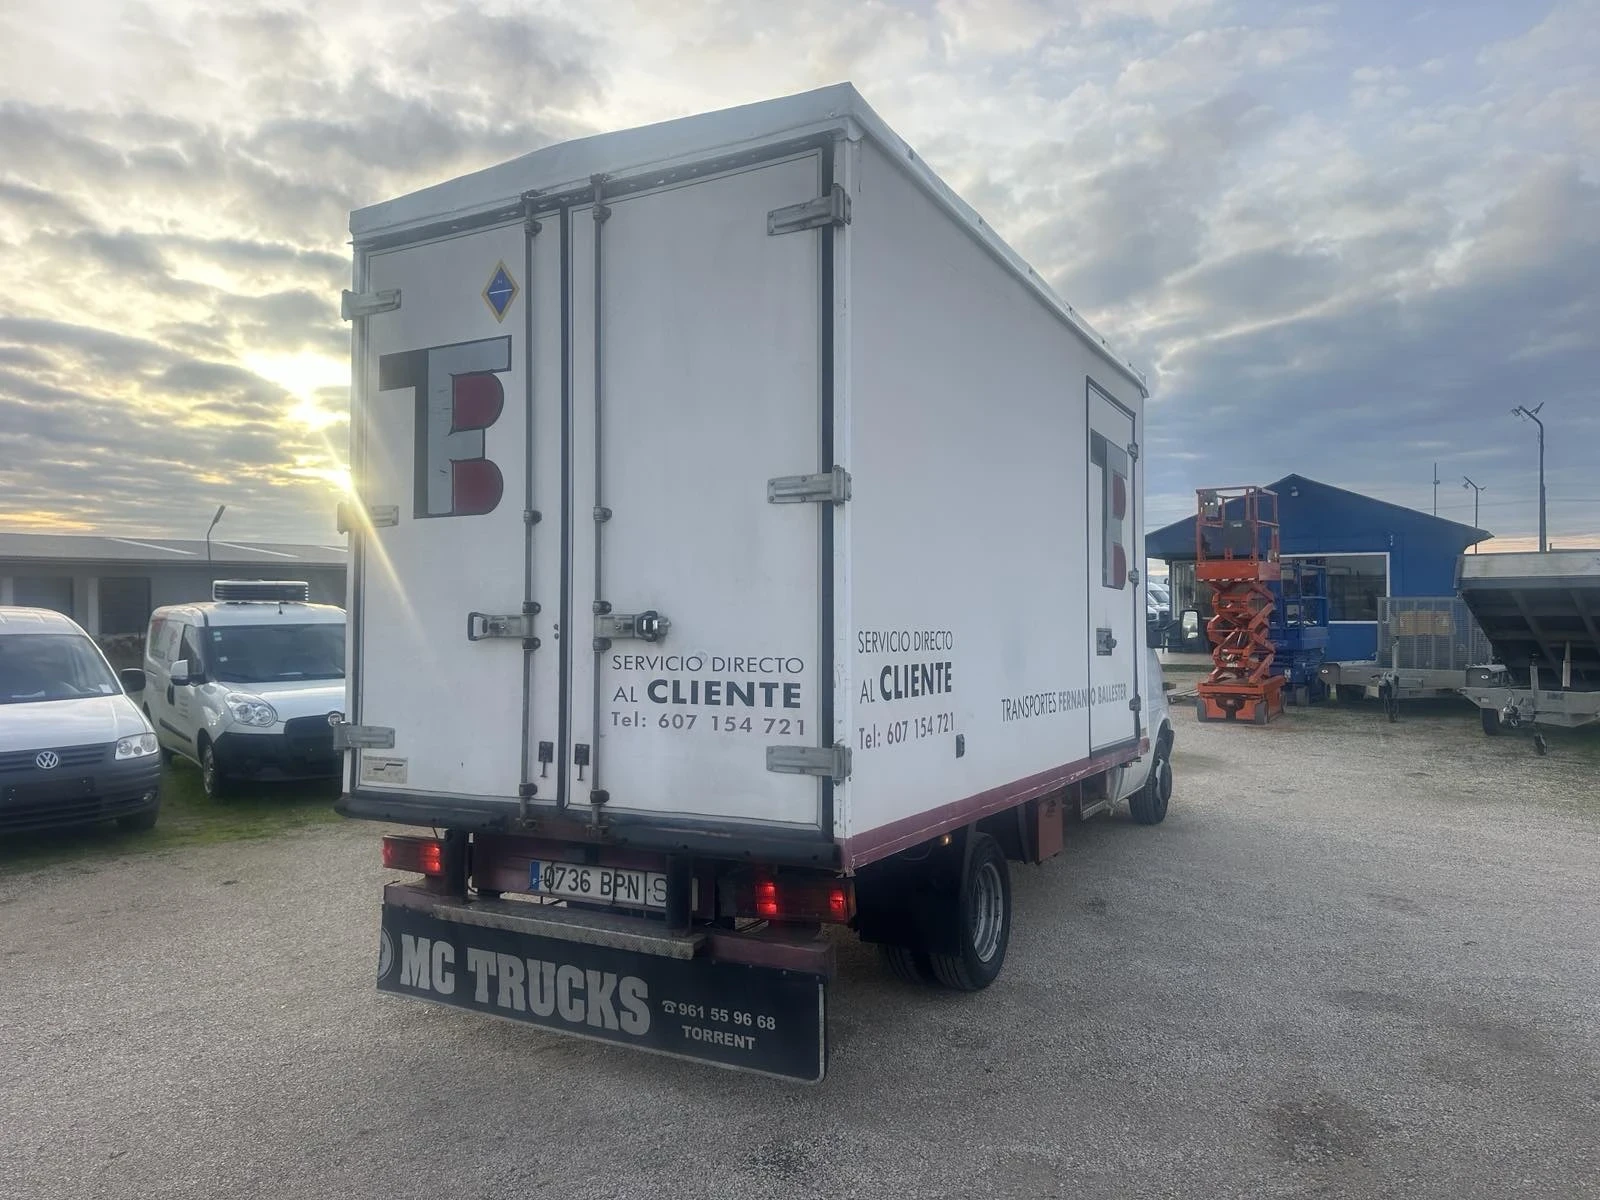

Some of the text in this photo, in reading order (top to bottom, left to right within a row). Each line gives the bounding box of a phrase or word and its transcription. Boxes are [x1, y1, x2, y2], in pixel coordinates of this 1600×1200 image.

[858, 630, 953, 654] SERVICIO DIRECTO
[612, 655, 804, 674] SERVICIO DIRECTO
[613, 679, 801, 709] AL CLIENTE
[860, 661, 952, 704] AL CLIENTE
[1001, 692, 1057, 722] TRANSPORTES
[1058, 687, 1096, 712] FERNANO
[611, 711, 804, 736] Tel: 607 154 721
[859, 712, 954, 750] Tel: 607 154 721
[543, 865, 591, 893] 0736
[600, 871, 639, 900] BPN
[400, 933, 651, 1035] MC TRUCKS
[678, 1002, 776, 1030] 961 55 96 68
[681, 1025, 755, 1050] TORRENT
